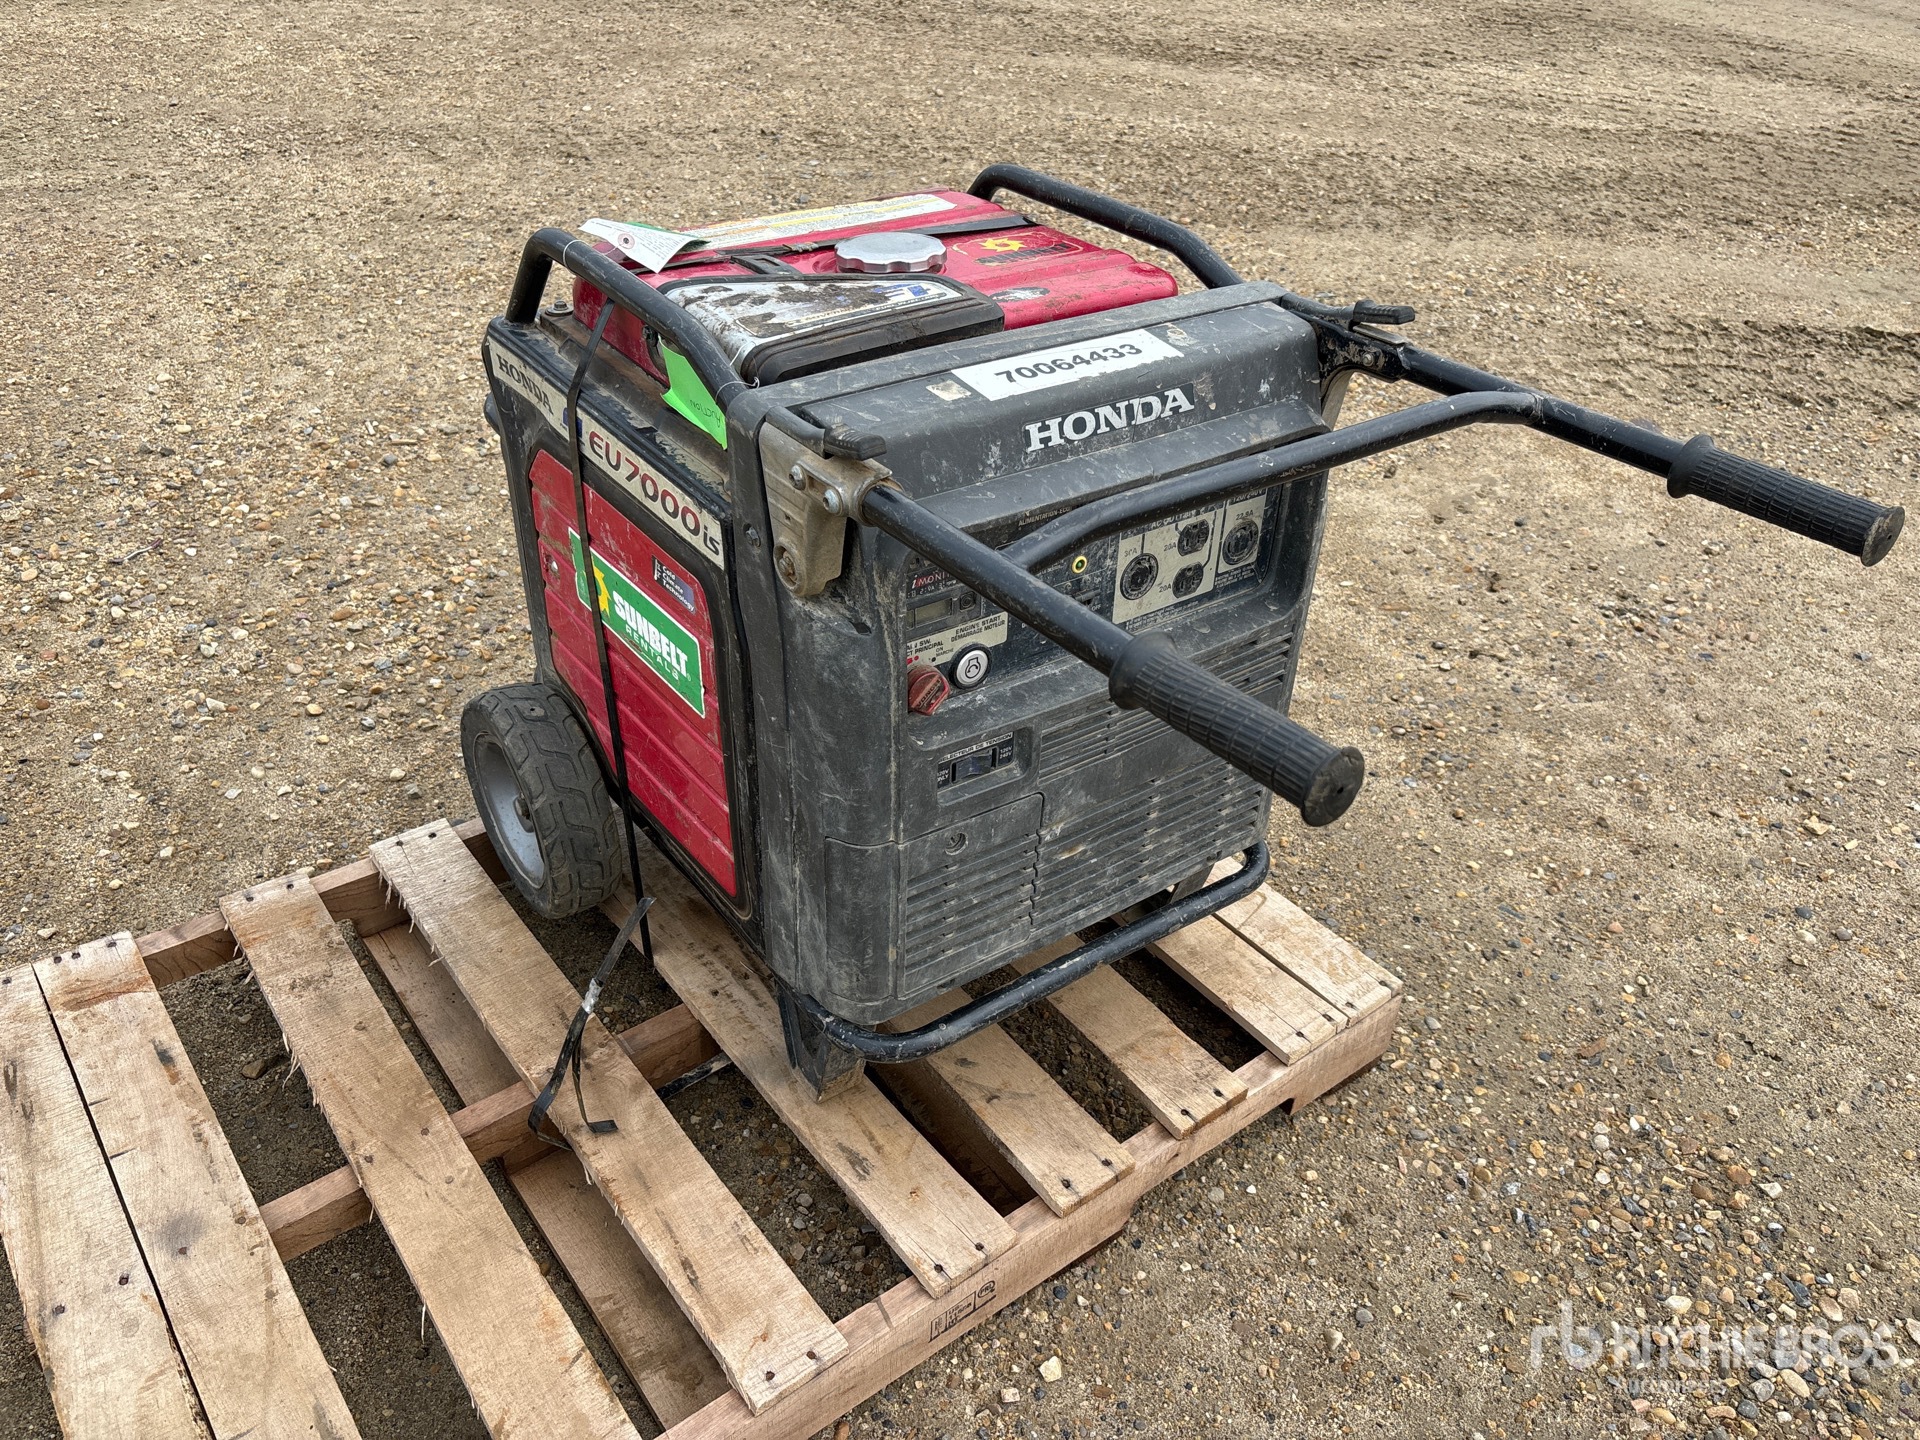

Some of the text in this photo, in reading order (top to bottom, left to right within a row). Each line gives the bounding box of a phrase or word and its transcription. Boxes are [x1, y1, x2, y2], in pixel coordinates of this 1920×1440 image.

[994, 343, 1143, 384] 70064433
[497, 354, 554, 416] HONDA
[1025, 387, 1194, 453] HONDA
[662, 565, 676, 580] Cold
[662, 572, 684, 595] Climate
[662, 578, 695, 612] Technology
[612, 590, 689, 678] SUNBELT
[955, 614, 1002, 635] ENGINE START
[984, 619, 1006, 632] MOTEUR
[625, 623, 680, 682] RENTALS
[914, 640, 944, 655] PRINCIPAL
